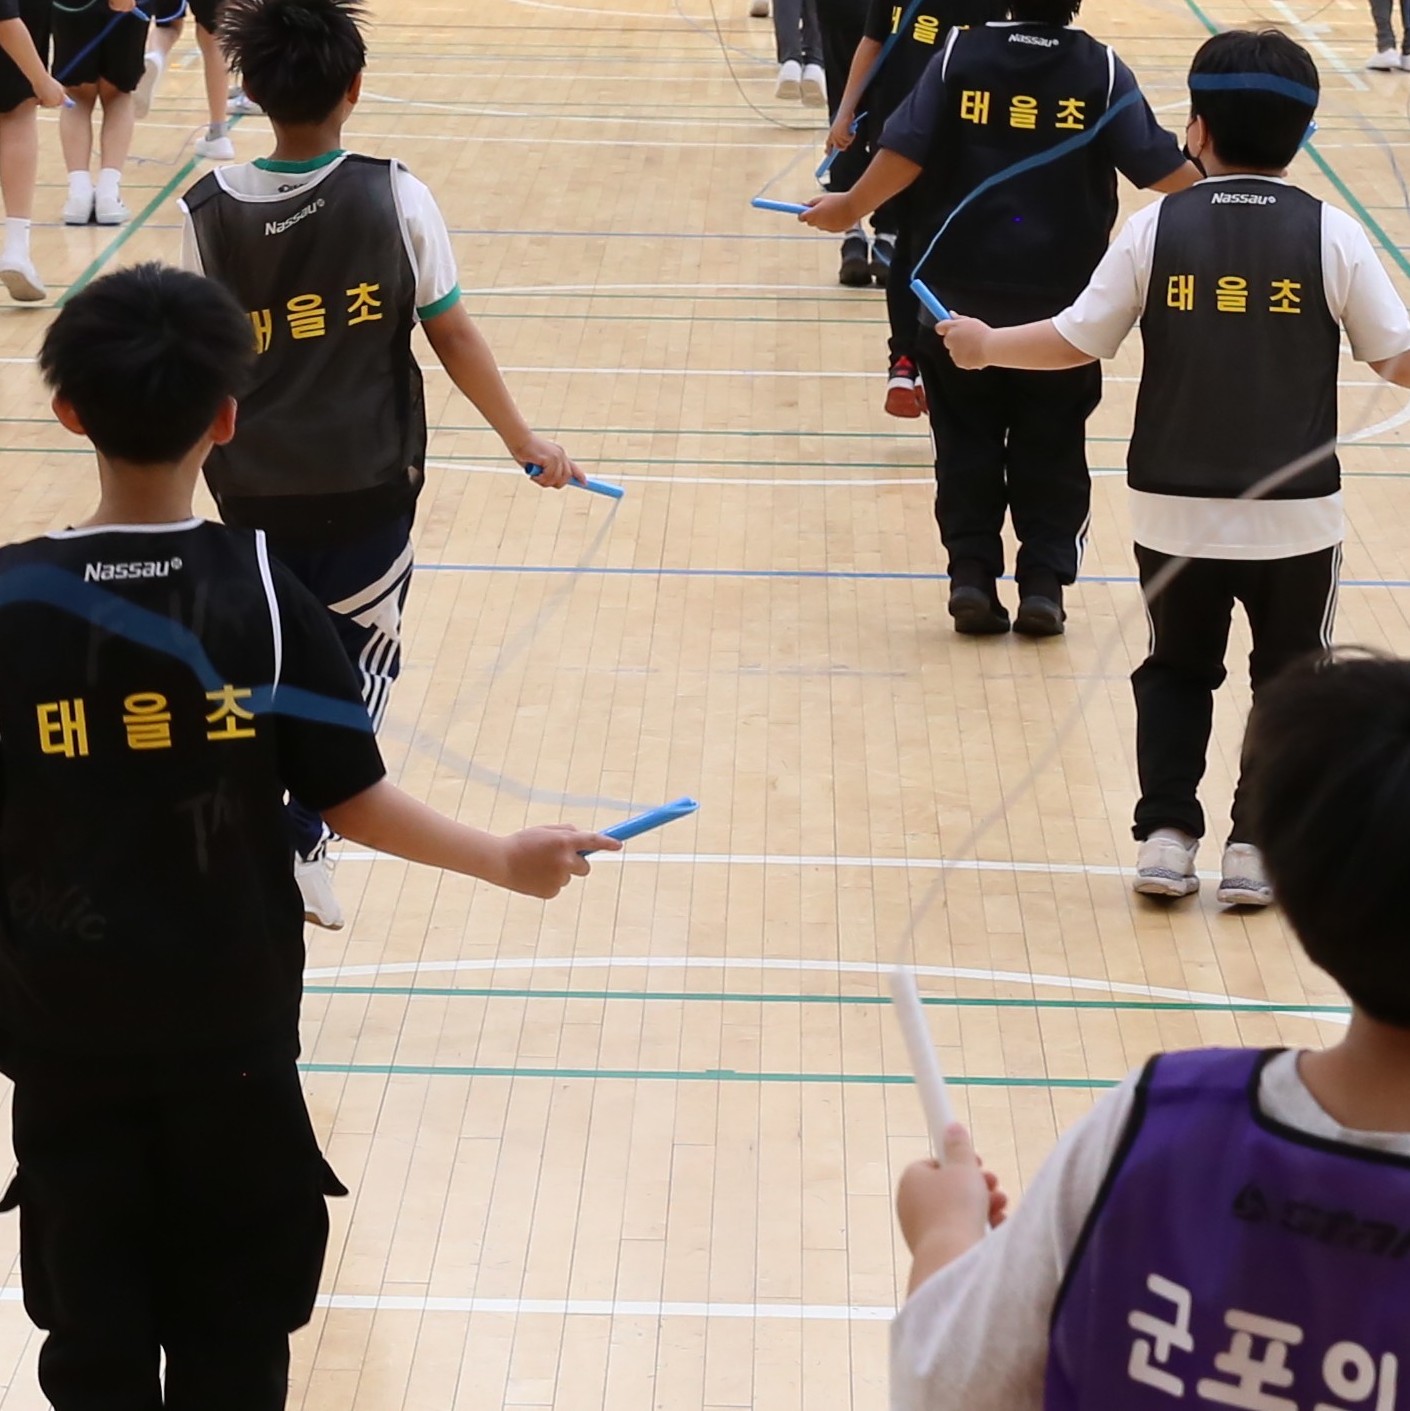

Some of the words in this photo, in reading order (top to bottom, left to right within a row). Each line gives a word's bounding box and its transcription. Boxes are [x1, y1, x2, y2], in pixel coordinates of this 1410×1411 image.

[960, 89, 1086, 131] 태을초
[265, 200, 318, 236] Nassau
[1211, 191, 1269, 206] Nassau
[1167, 273, 1302, 315] 태을초
[84, 560, 171, 584] Nassau
[36, 684, 257, 759] 태을초
